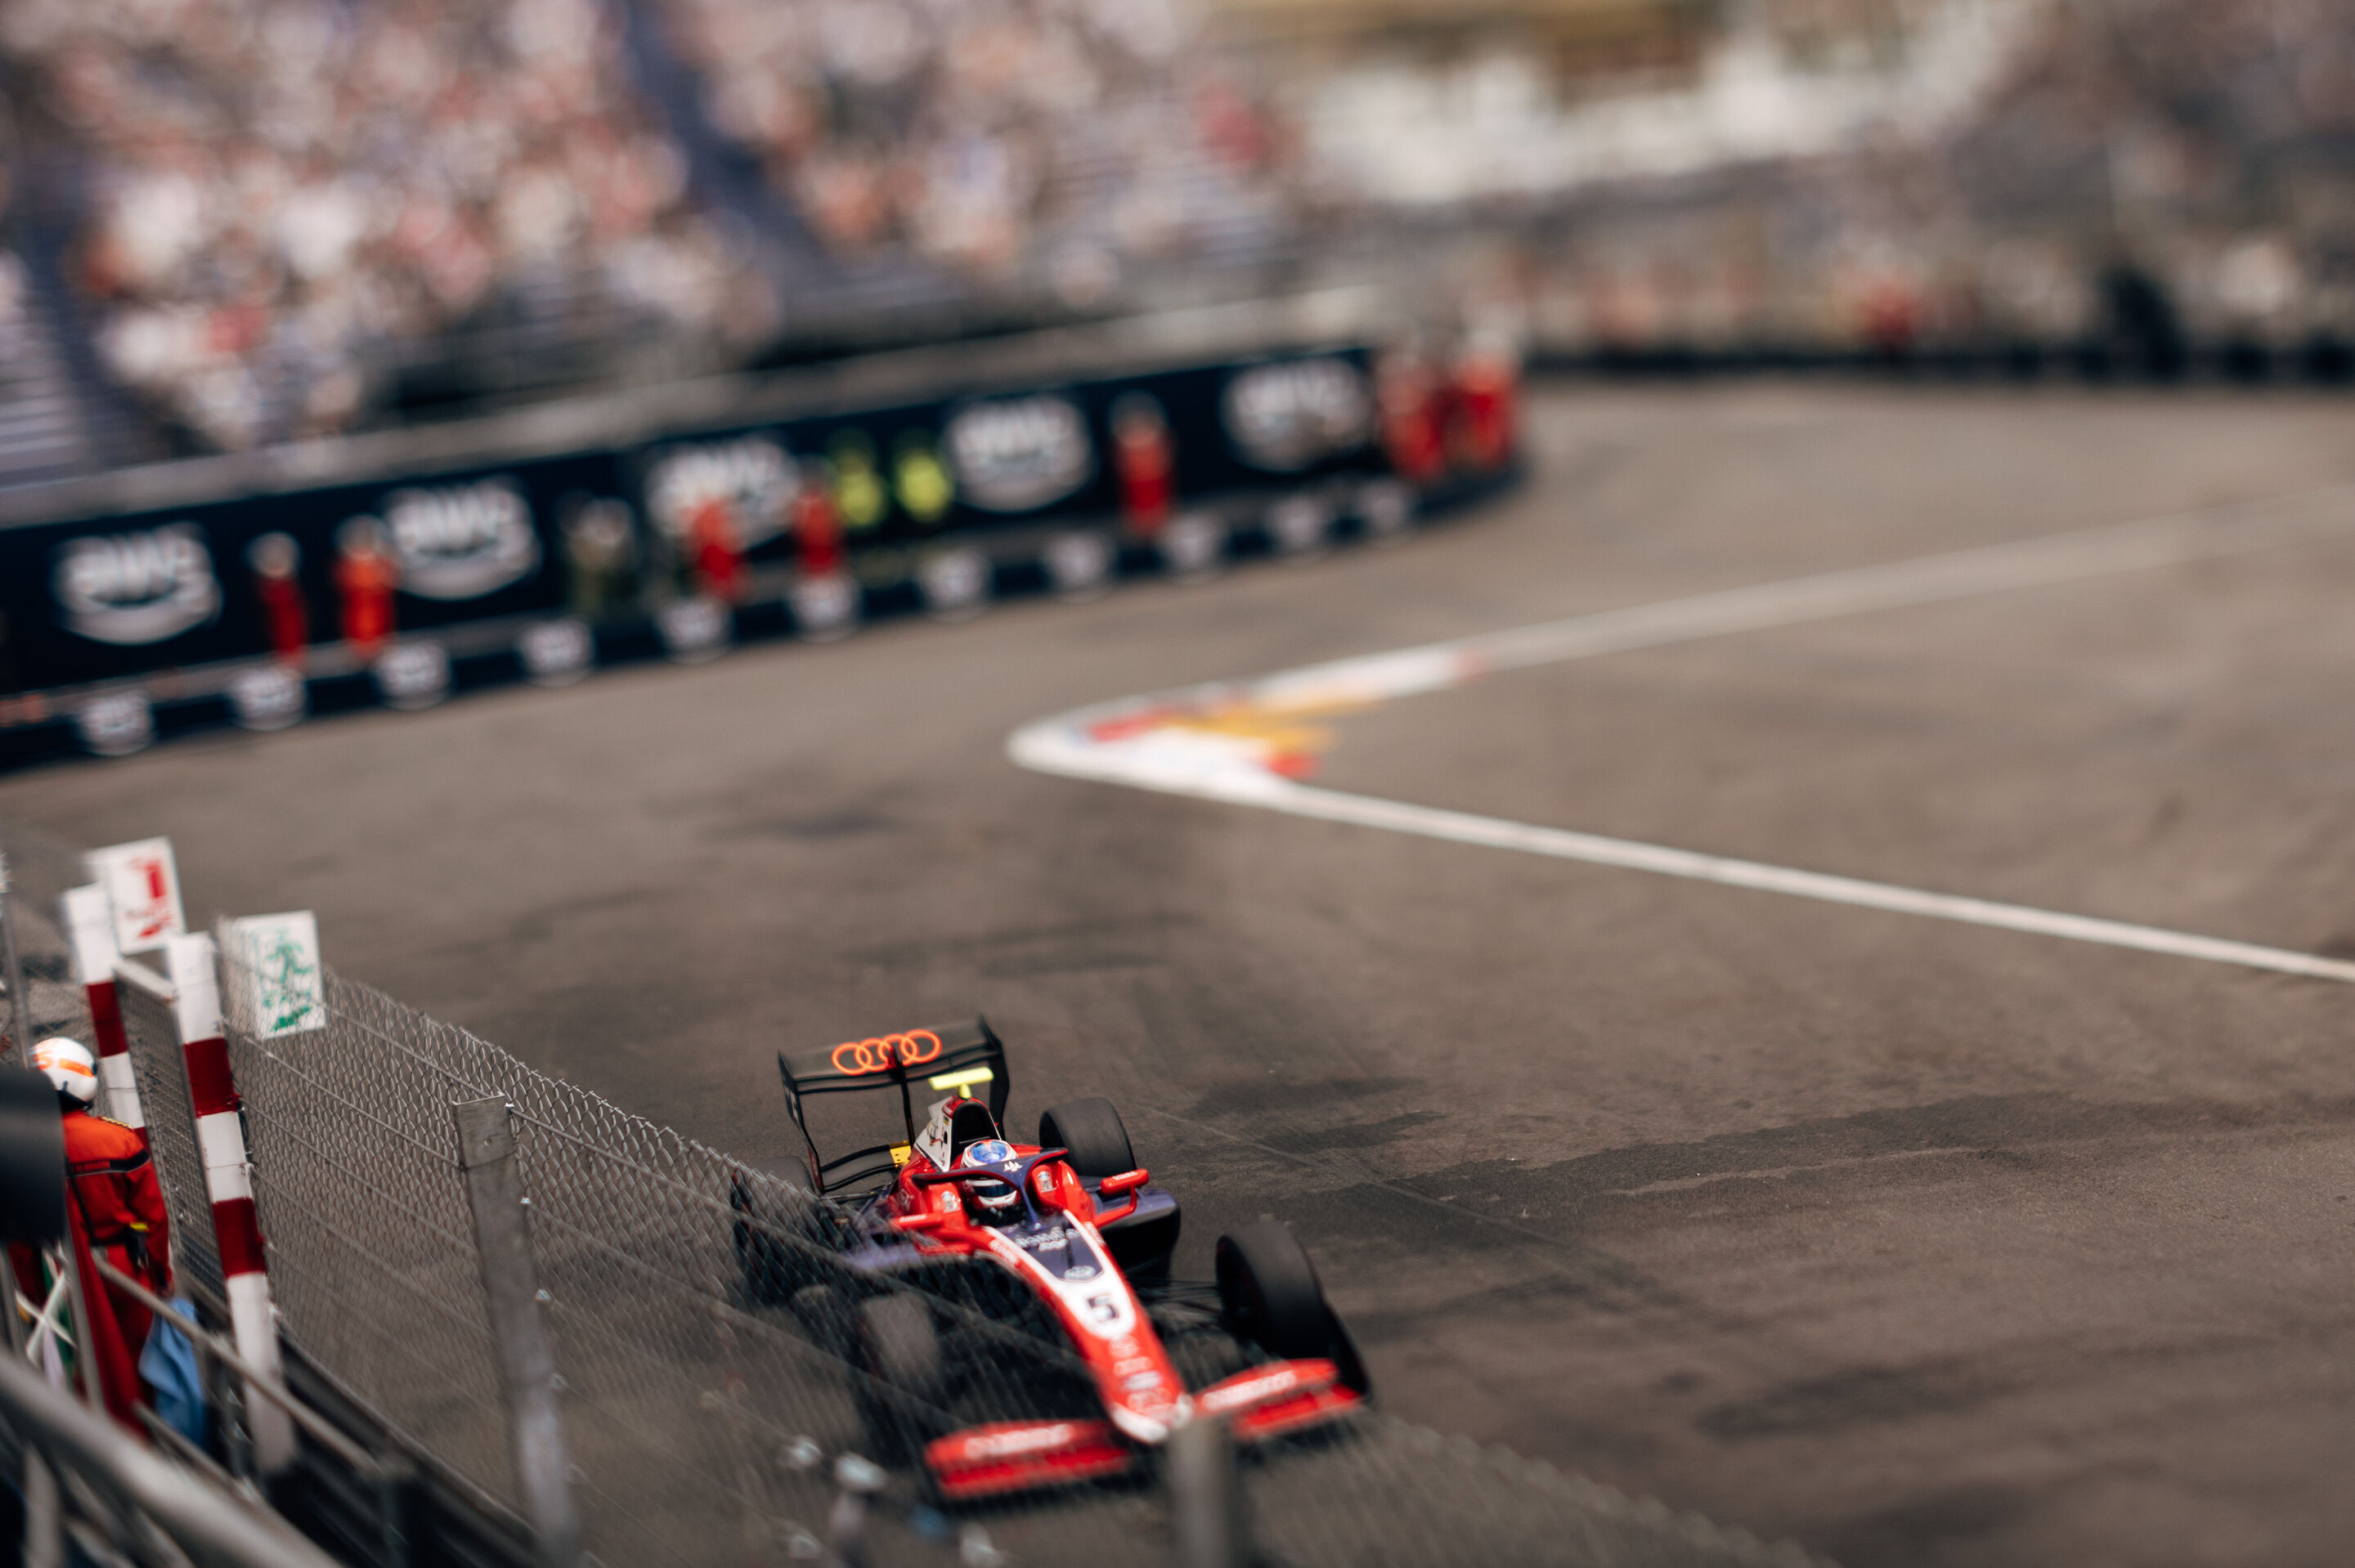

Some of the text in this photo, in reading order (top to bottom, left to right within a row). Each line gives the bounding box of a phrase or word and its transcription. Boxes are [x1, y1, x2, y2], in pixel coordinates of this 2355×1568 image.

[57, 526, 214, 619] aws
[392, 480, 541, 577] aws
[1087, 1293, 1119, 1322] 5
